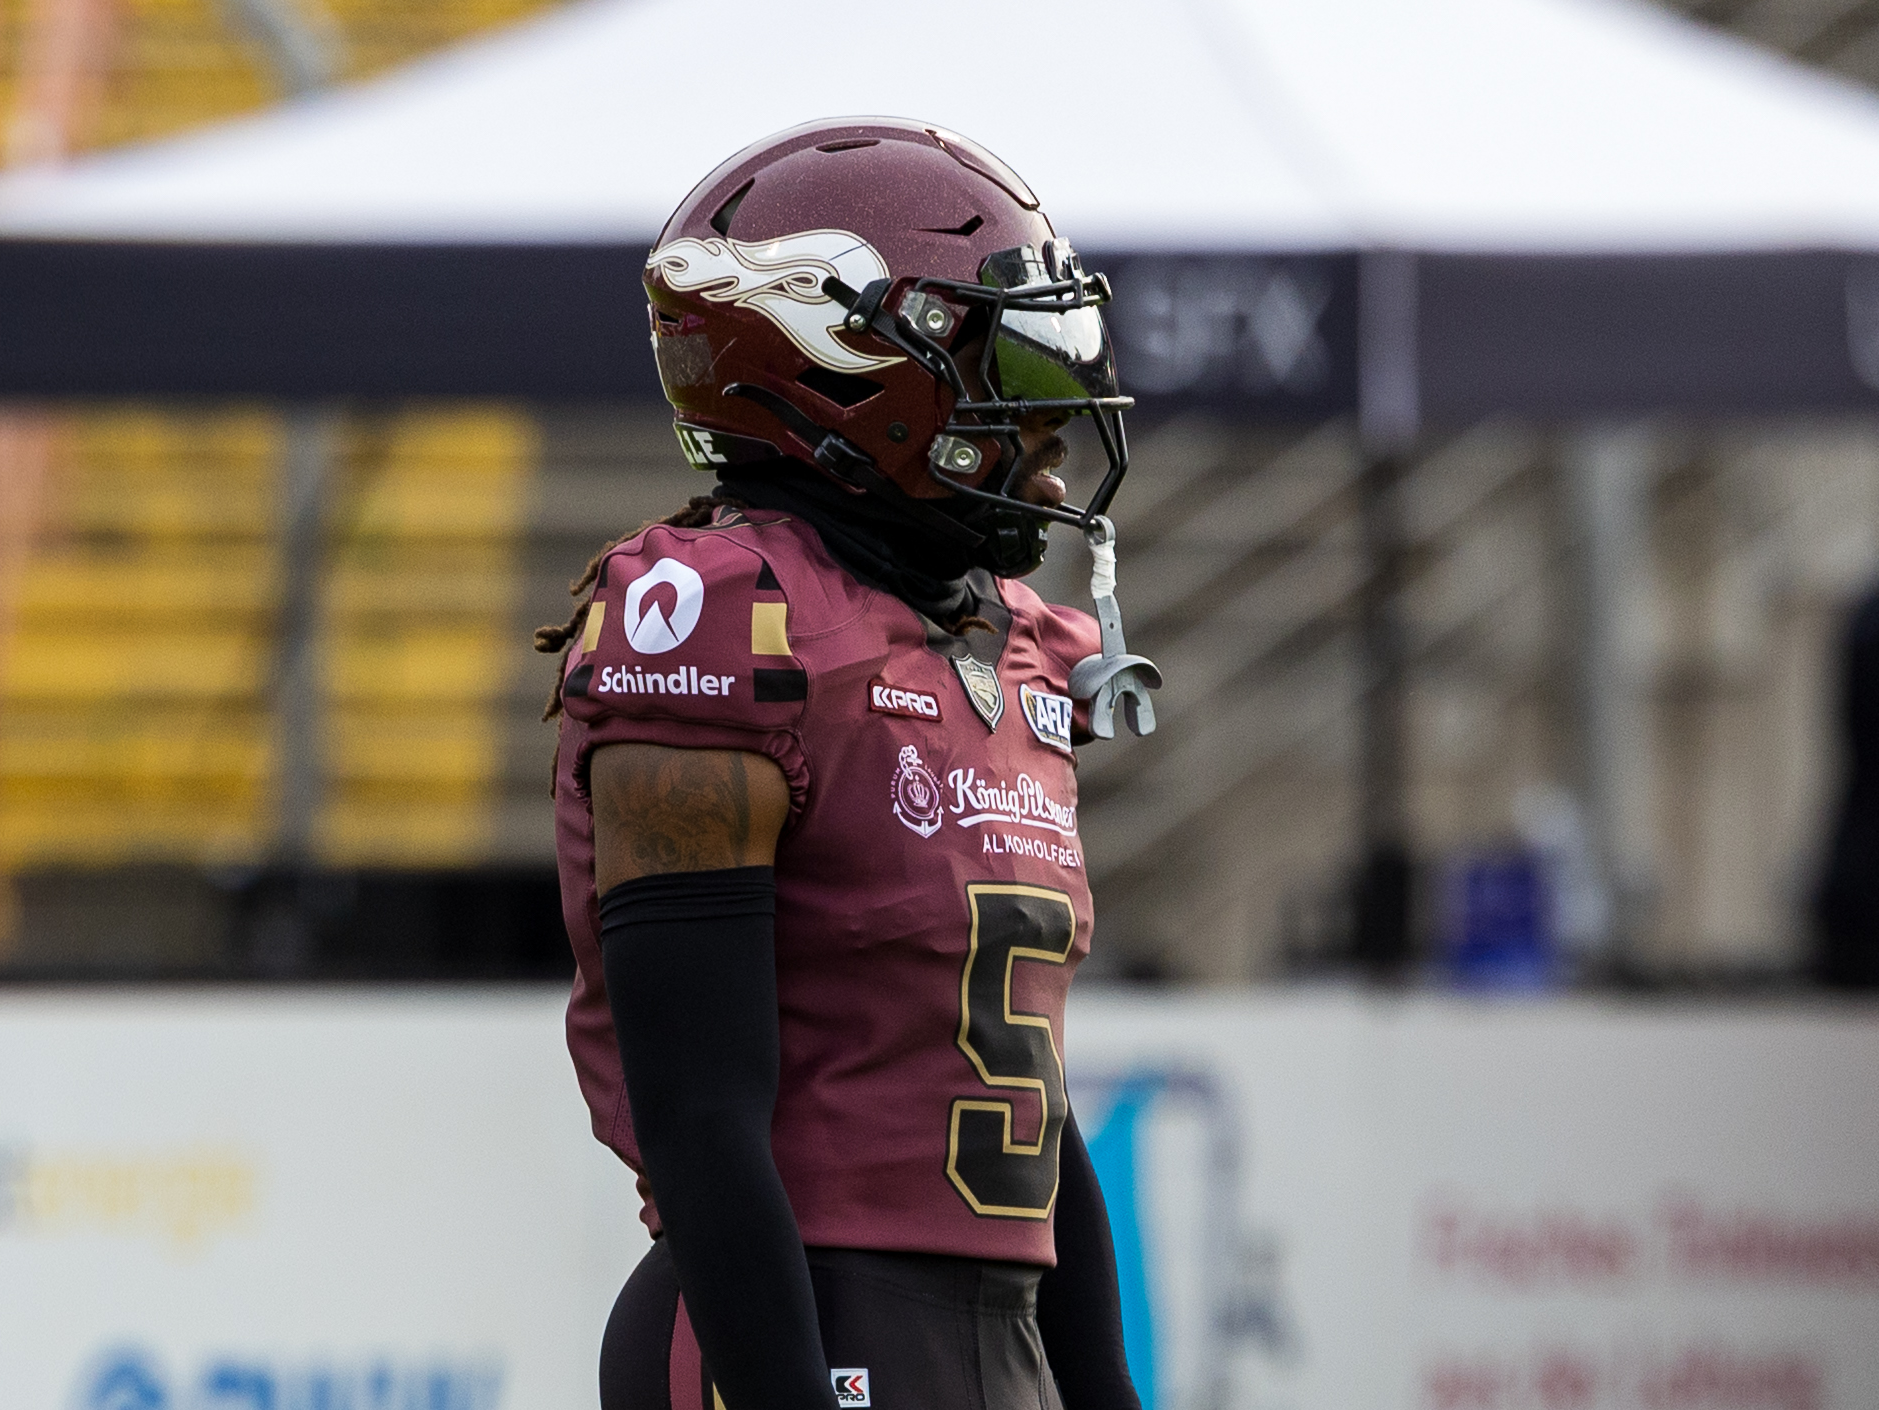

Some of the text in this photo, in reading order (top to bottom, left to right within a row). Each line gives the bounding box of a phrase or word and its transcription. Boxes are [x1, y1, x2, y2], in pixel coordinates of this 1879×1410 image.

[598, 664, 736, 696] Schindler
[982, 833, 1081, 867] ALKOHOLFREI
[946, 880, 1078, 1221] 5
[837, 1393, 866, 1402] PRO
